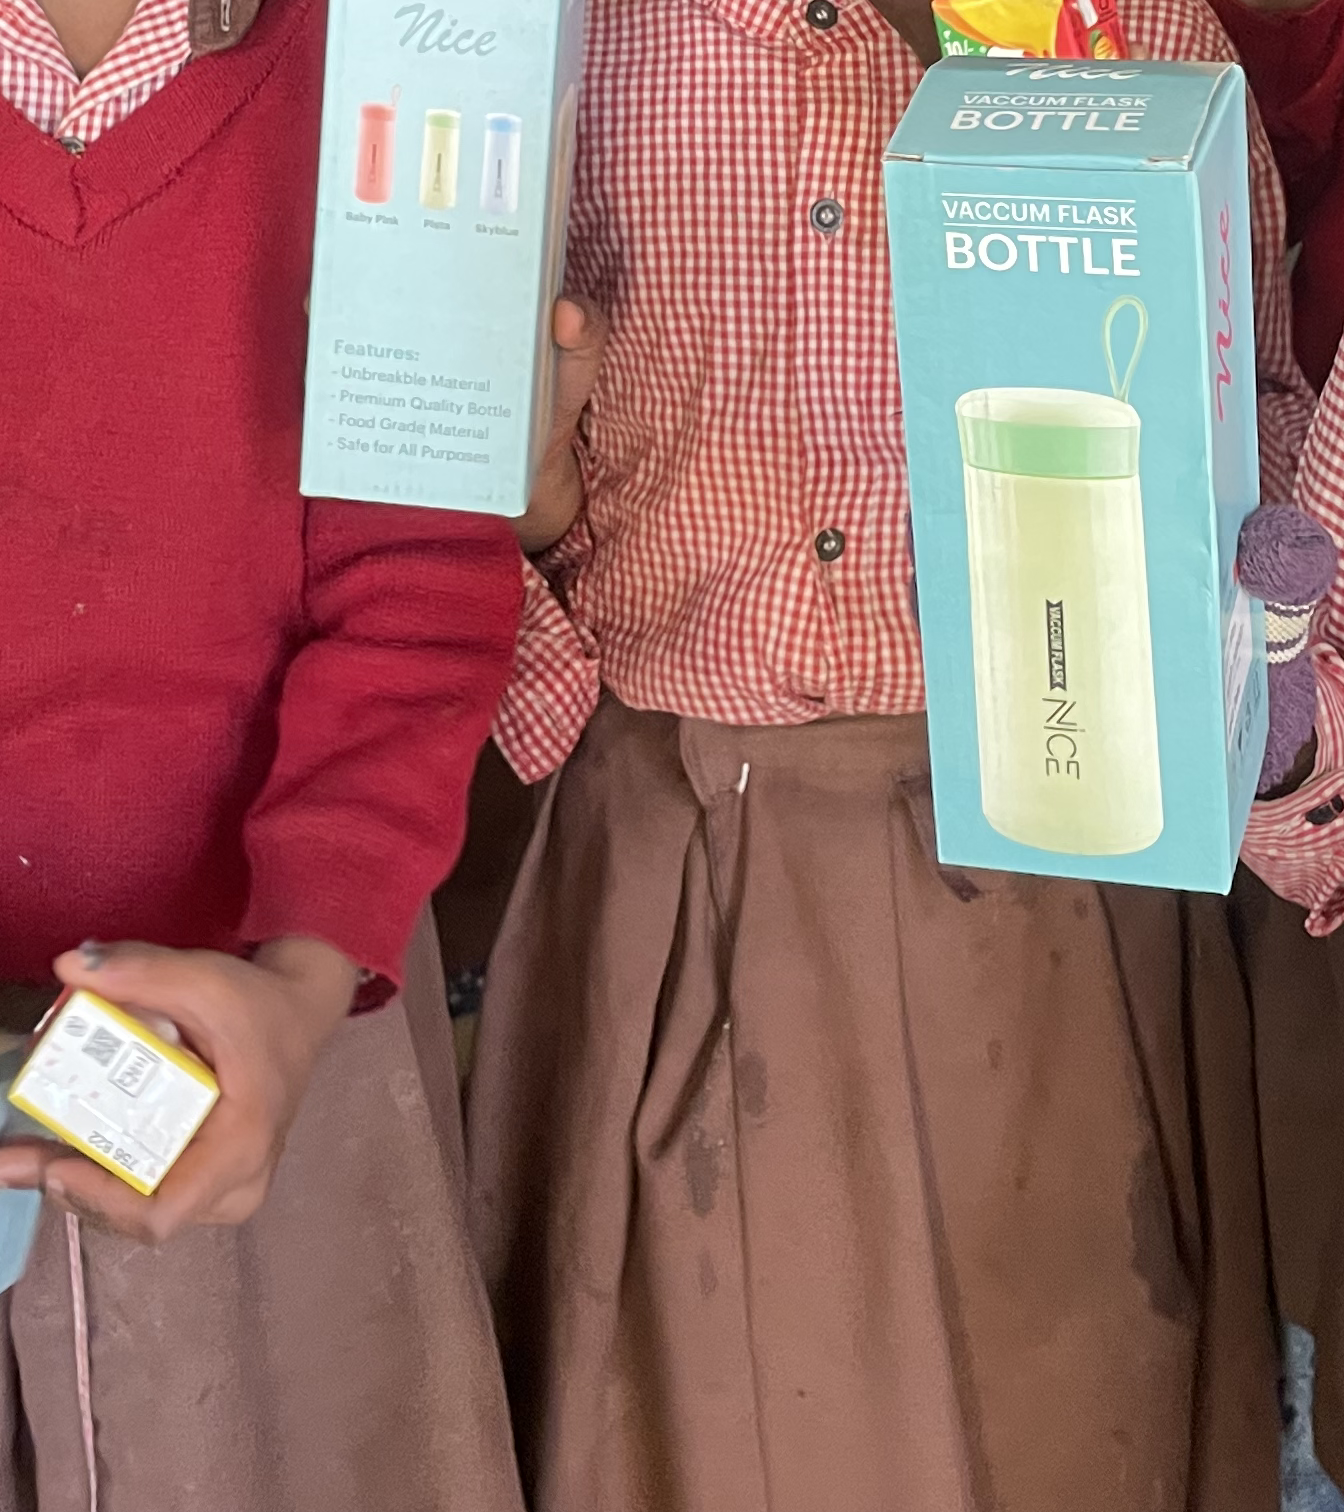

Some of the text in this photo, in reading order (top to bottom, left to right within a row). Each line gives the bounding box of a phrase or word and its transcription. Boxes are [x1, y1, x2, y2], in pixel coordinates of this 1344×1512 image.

[394, 2, 497, 57] Nice
[963, 94, 1151, 108] VACCUM FLASK
[950, 110, 1146, 132] BOTTLE
[941, 199, 1137, 228] VACCUM FLASK
[945, 230, 1141, 277] BOTTLE
[334, 339, 420, 362] Features:
[431, 375, 491, 392] Material
[339, 389, 406, 408] Premium
[410, 396, 464, 416] Quality
[468, 402, 512, 418] Bottle
[338, 413, 376, 429] Food
[379, 417, 425, 434] Grade
[429, 422, 489, 439] Material
[337, 437, 370, 453] Safe
[374, 440, 394, 454] for
[398, 443, 417, 457] All
[421, 445, 490, 464] Purposes
